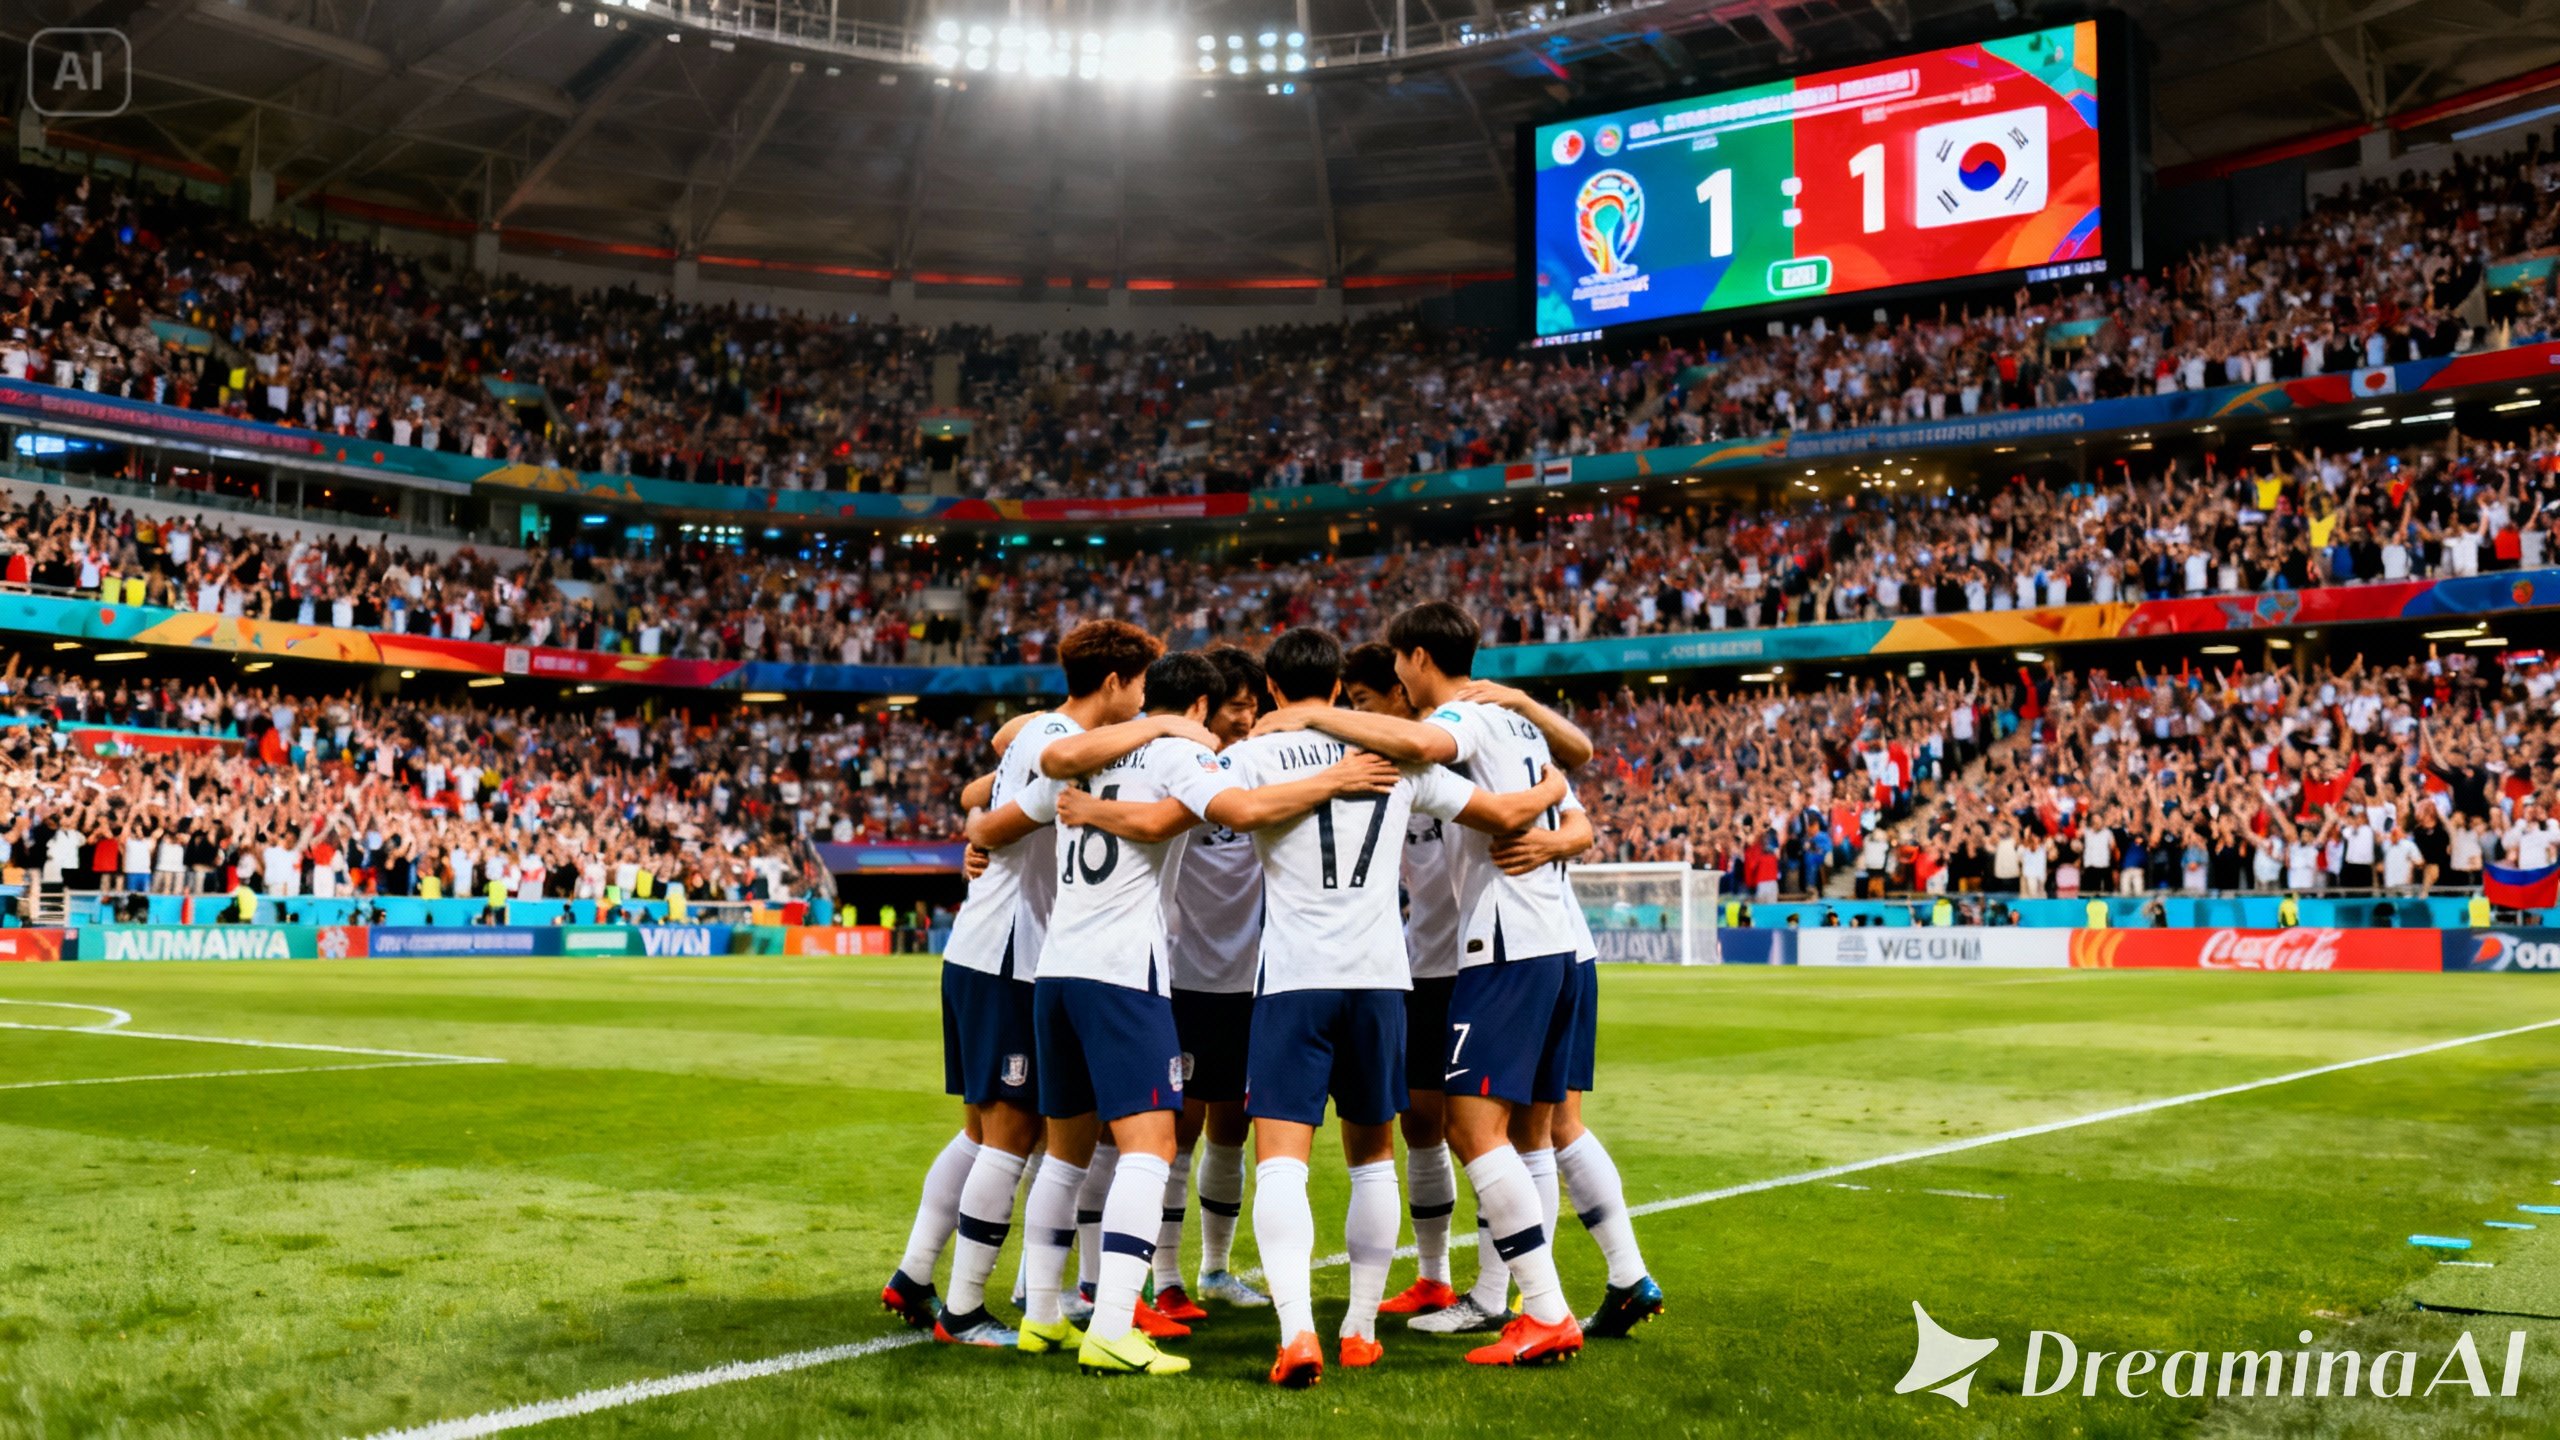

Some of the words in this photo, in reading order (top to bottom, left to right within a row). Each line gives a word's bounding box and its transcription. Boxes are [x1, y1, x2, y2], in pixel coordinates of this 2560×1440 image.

[1696, 168, 1733, 258] 1
[1849, 143, 1886, 234] 1
[1316, 792, 1391, 889] 17
[1451, 1023, 1471, 1064] 7
